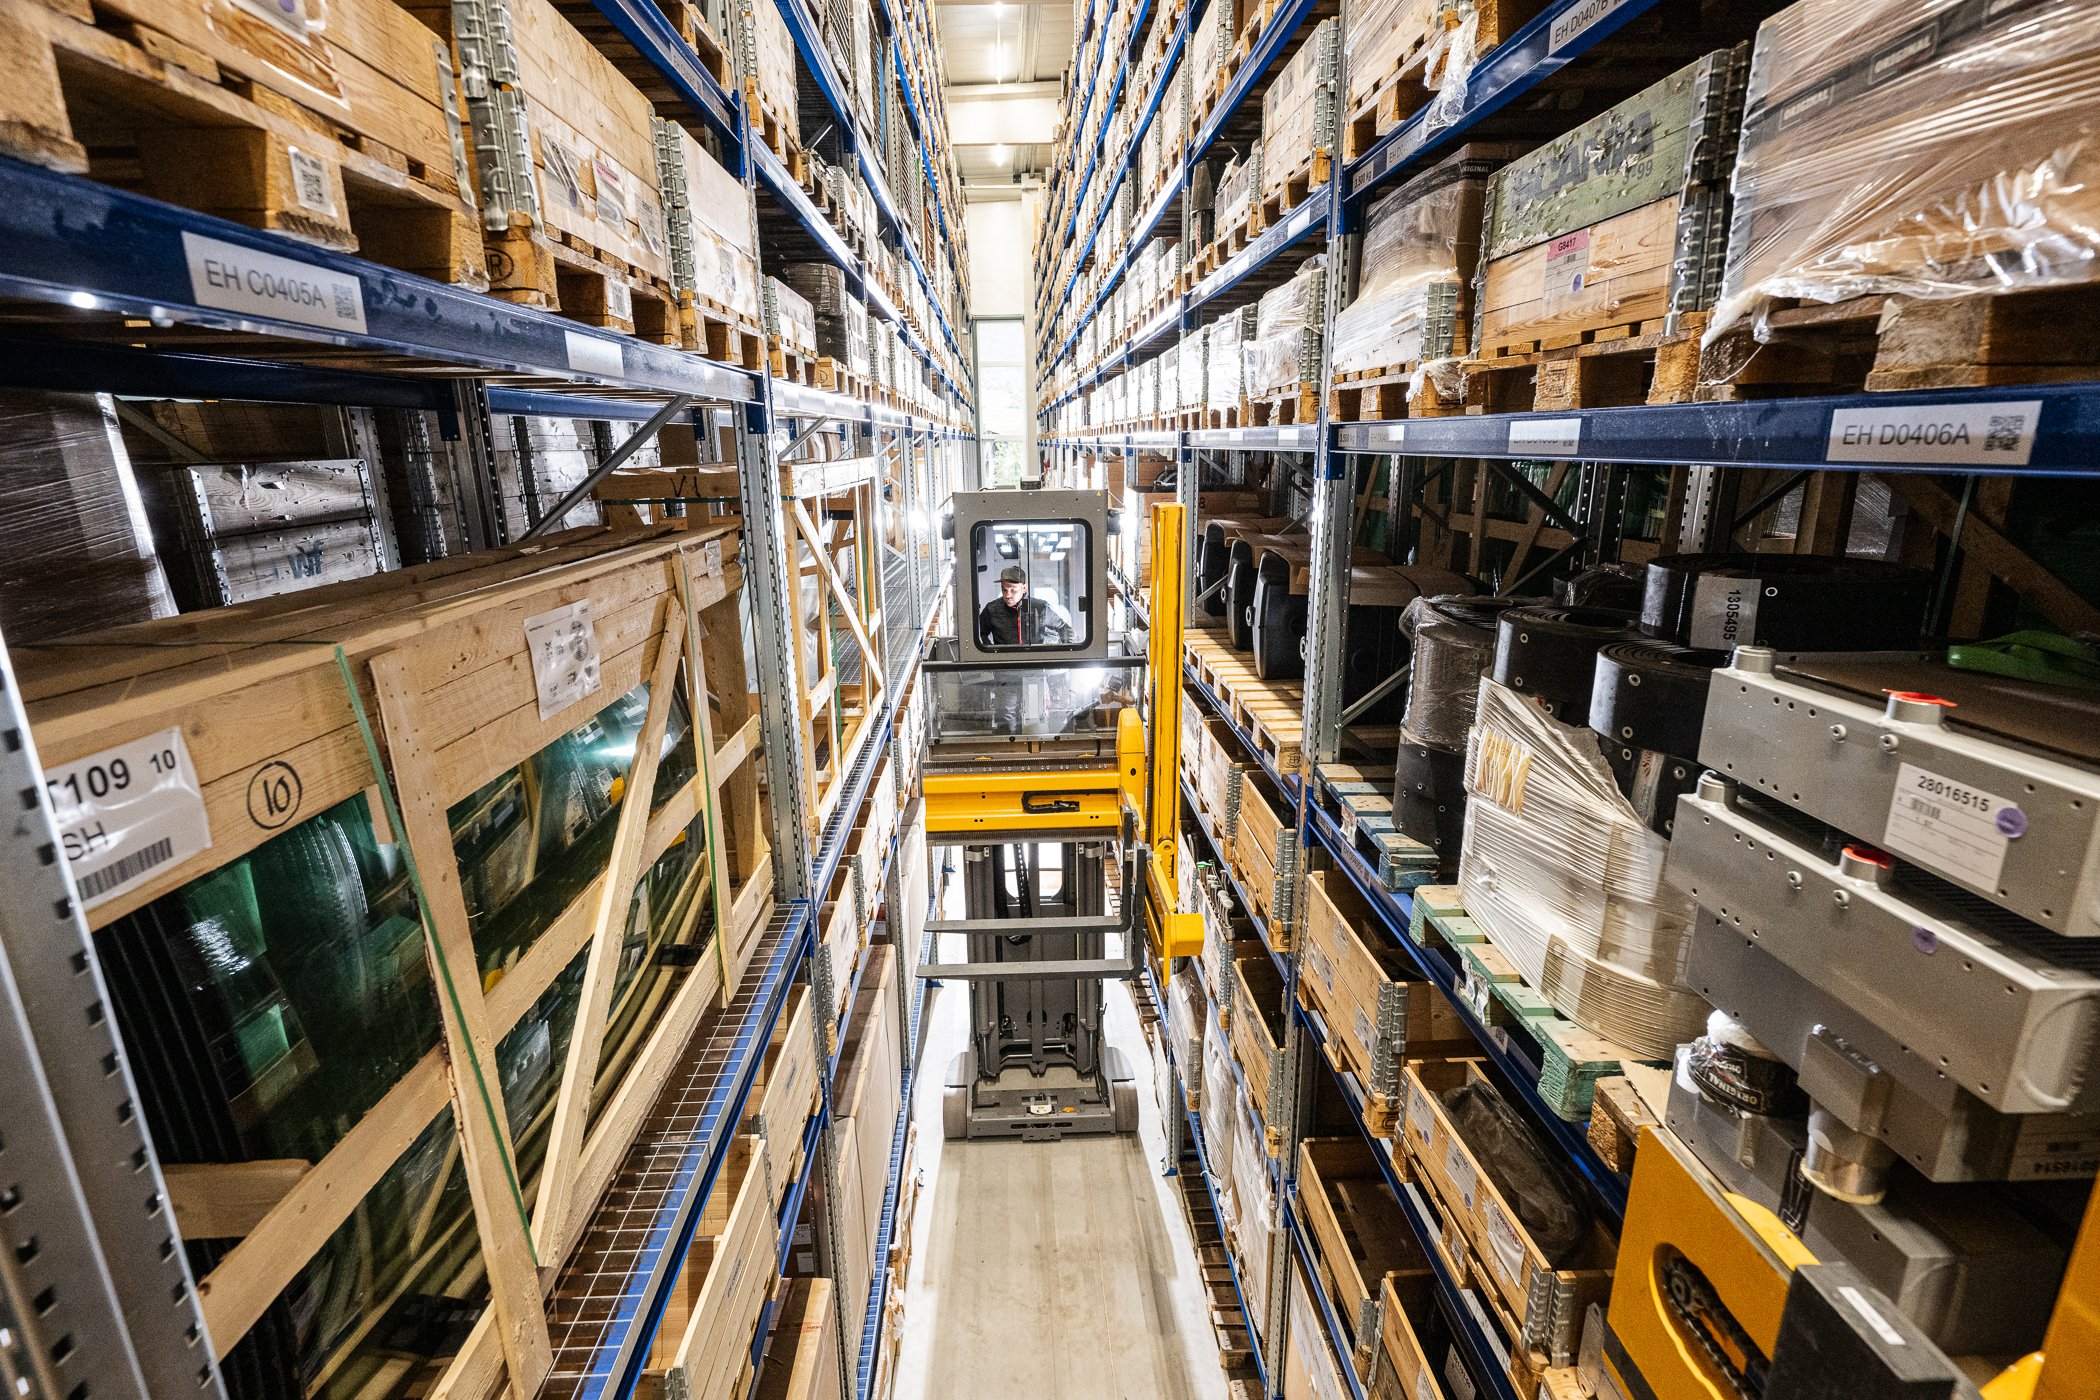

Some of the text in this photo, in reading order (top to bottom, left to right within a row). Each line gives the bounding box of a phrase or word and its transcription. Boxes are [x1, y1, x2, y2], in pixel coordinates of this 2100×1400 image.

[1554, 0, 1608, 44] EH D0407B
[1558, 237, 1577, 251] G8417
[204, 259, 327, 309] EH C0405A
[1843, 423, 1970, 446] EH D0406A
[1722, 589, 1742, 641] 1305495
[149, 749, 176, 774] 10
[263, 774, 291, 817] 10
[1917, 775, 1990, 812] 28016515
